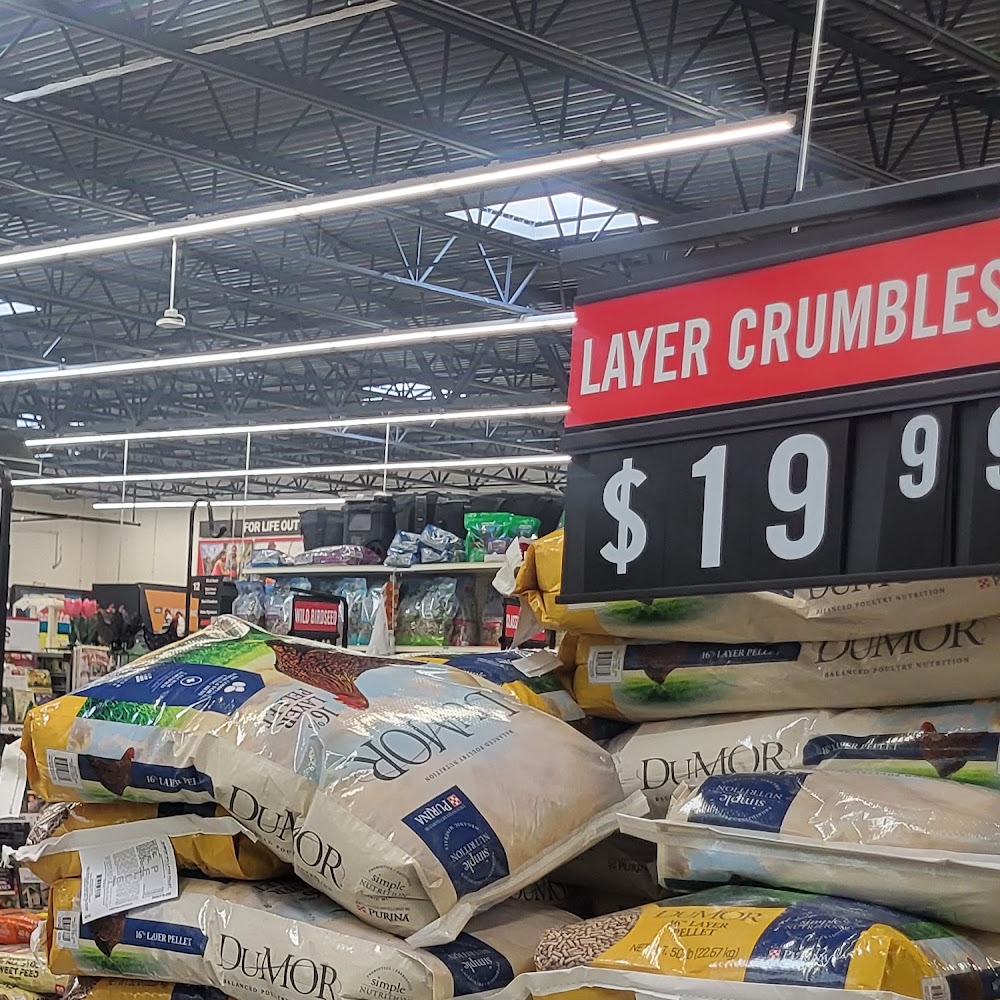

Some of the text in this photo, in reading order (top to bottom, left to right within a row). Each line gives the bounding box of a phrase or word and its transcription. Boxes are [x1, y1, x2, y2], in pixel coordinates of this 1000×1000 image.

[579, 260, 1000, 396] LAYER CRUMBLES
[244, 519, 300, 534] FOR LIFE OUT
[295, 607, 337, 626] WILD BIRDSEED
[716, 648, 745, 659] LAYER
[824, 656, 970, 679] BALANCED POULTRY NUTRITION
[283, 692, 327, 730] LAYER
[718, 793, 766, 811] simple
[413, 799, 449, 826] PURINA
[450, 832, 491, 863] NUTRITION
[462, 848, 491, 874] simple
[371, 873, 406, 892] simple
[368, 908, 410, 924] PURINA
[689, 920, 729, 930] LAYER
[167, 934, 193, 947] PELLET
[673, 927, 717, 938] PELLET
[20, 967, 40, 979] FEED
[370, 976, 406, 995] simple
